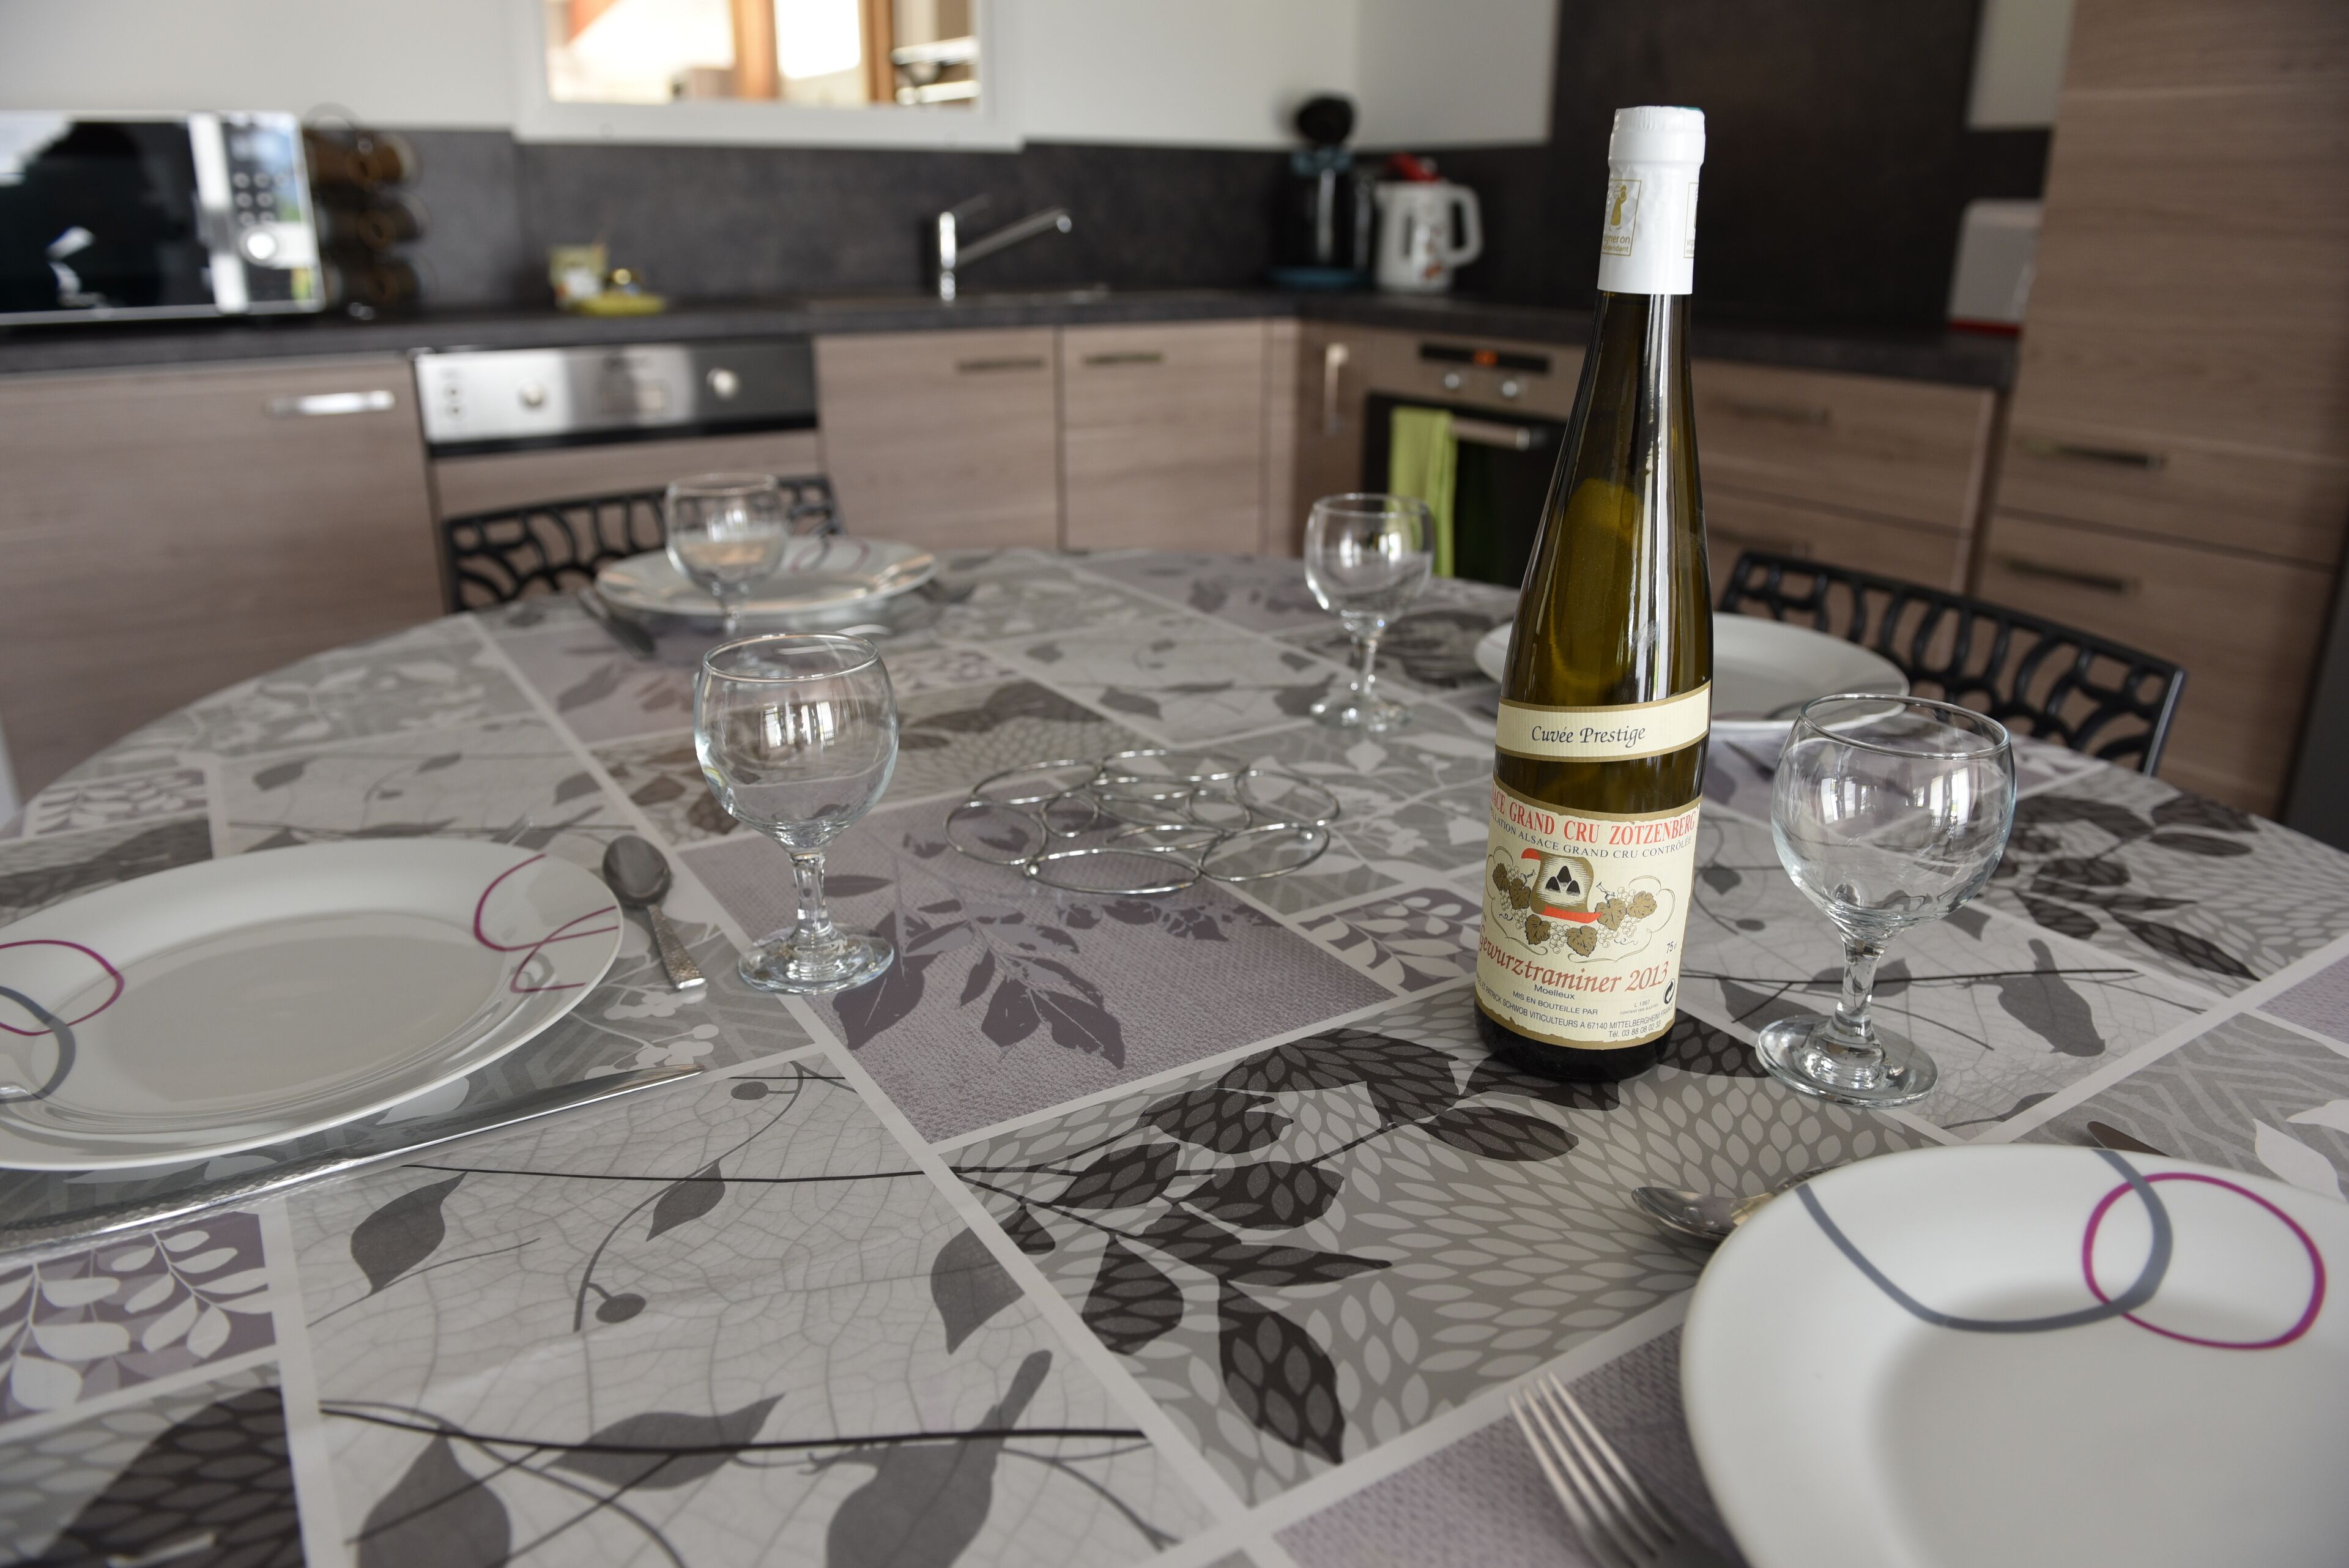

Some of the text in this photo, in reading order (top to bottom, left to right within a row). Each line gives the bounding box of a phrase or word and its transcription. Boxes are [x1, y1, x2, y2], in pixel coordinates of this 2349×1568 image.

[1532, 726, 1646, 748] Cuvée Prestige
[1509, 801, 1555, 835] GRAND
[1564, 820, 1600, 844] CRU
[1609, 811, 1696, 845] ZOTZENBERG
[1518, 831, 1559, 850] ALSACE
[1563, 844, 1608, 858] GRAND
[1613, 850, 1638, 858] CRU
[1642, 836, 1691, 857] CONTRÔLÉE
[1479, 924, 1669, 993] Gewurztraminer 2013
[1666, 942, 1674, 954] 75
[1513, 990, 1524, 1001] MIS
[1538, 1001, 1580, 1014] BOUTEILLE
[1534, 984, 1575, 1000] Moelleux
[1486, 986, 1501, 1003] PATRICK
[1503, 998, 1527, 1016] SCHWOB
[1529, 1011, 1578, 1028] VITICULTEURS
[1609, 1014, 1660, 1029] MITTELBERGHEIM
